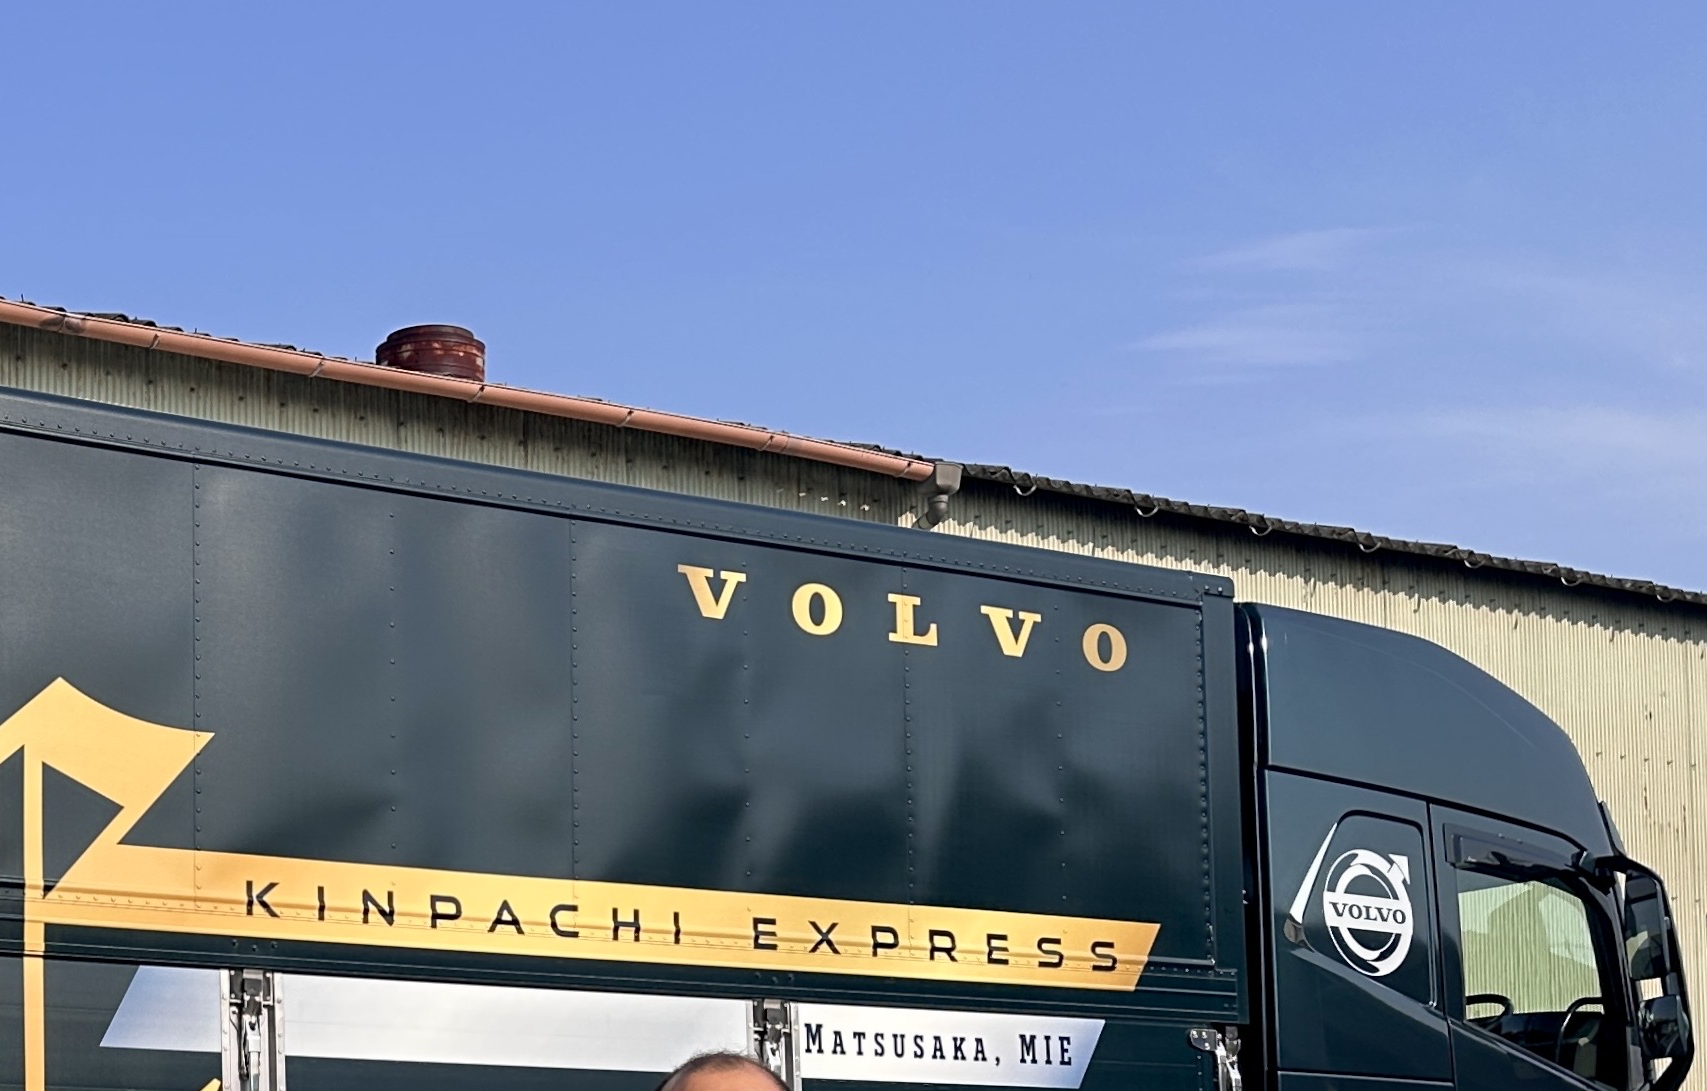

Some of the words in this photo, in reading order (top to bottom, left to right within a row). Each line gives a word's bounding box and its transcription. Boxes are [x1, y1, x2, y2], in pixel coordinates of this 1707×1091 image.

[676, 563, 1129, 672] VOLVO
[243, 879, 684, 947] KINPACHI
[752, 916, 1121, 973] EXPRESS
[1329, 901, 1407, 925] VOLVO
[1019, 1033, 1074, 1067] MIE
